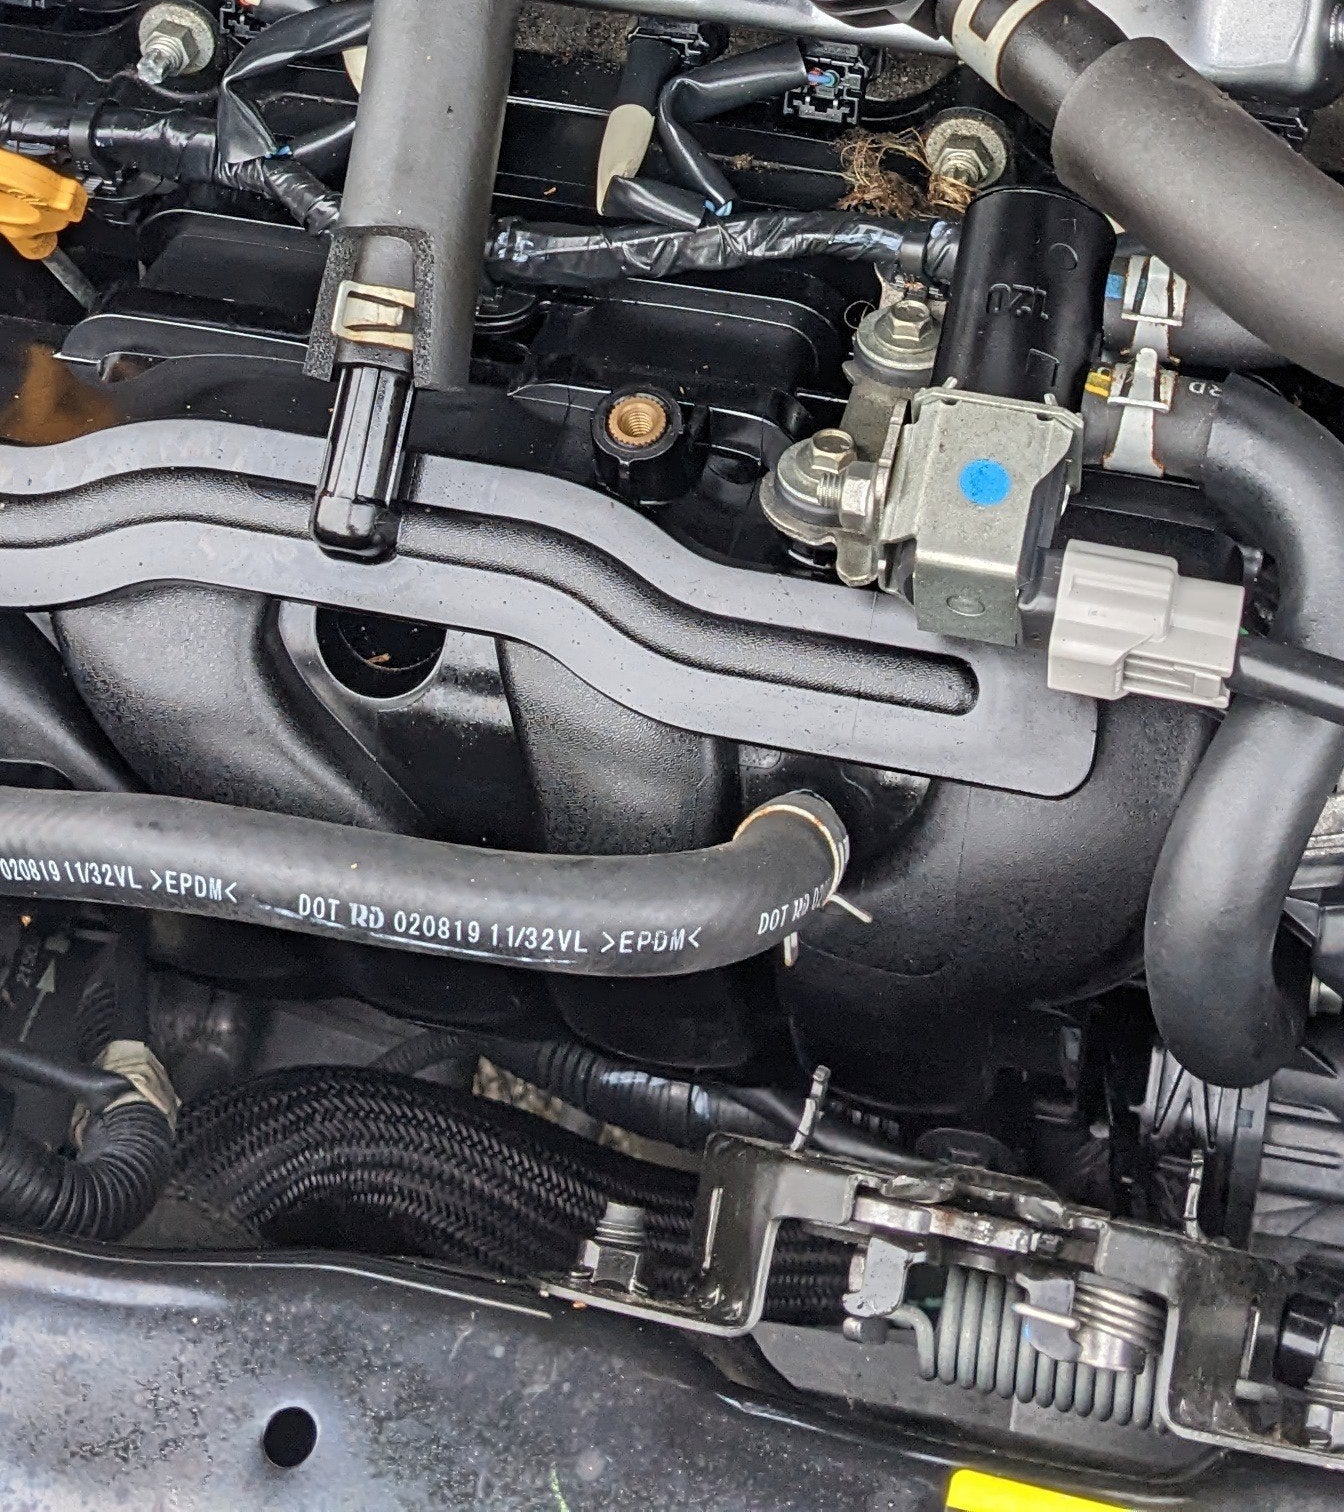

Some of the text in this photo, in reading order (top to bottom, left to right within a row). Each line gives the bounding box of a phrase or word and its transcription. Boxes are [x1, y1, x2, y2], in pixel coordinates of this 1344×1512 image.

[0, 856, 61, 883] 020819
[298, 892, 340, 922] DOT
[393, 904, 482, 944] 020819
[756, 904, 790, 936] DOT
